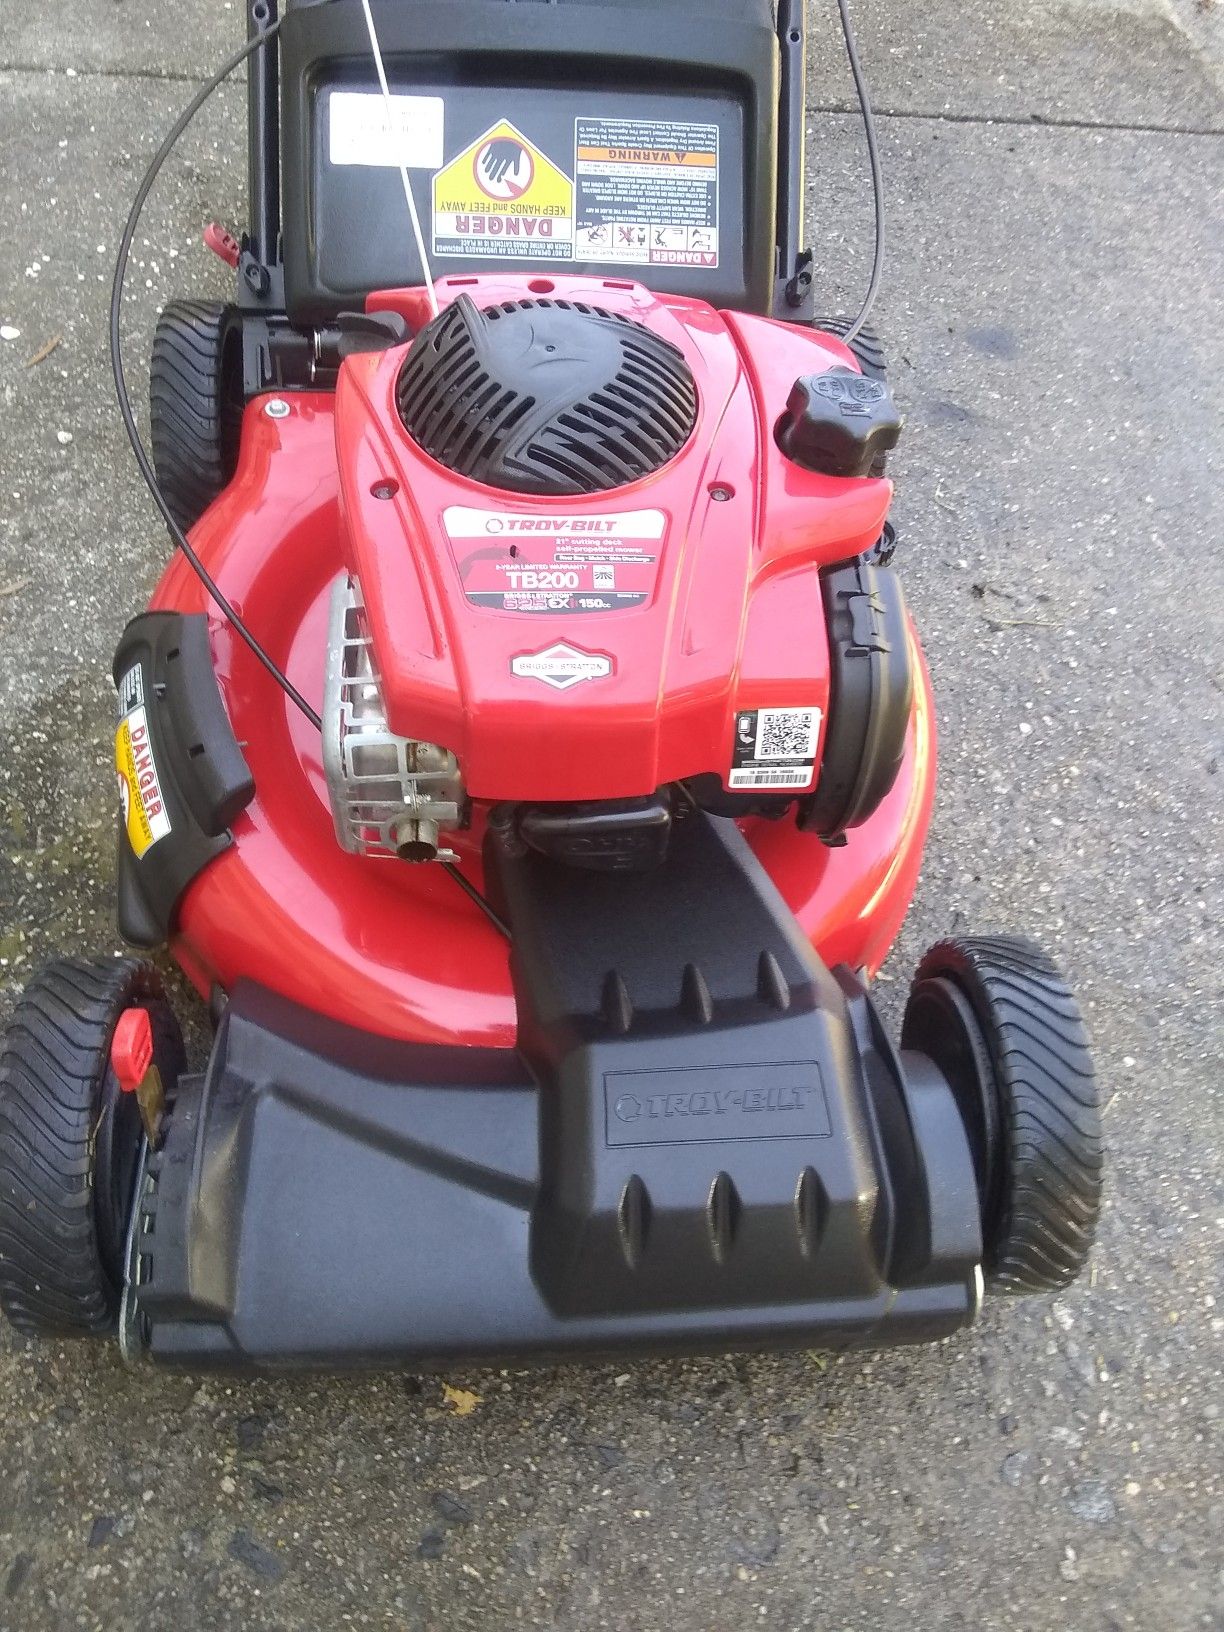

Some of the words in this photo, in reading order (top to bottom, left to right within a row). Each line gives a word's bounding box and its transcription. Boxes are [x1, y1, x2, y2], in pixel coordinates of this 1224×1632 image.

[608, 150, 670, 162] WARNING
[440, 201, 466, 211] AWAY
[470, 202, 490, 212] FEET
[493, 203, 508, 212] and
[511, 204, 540, 215] HANDS
[543, 205, 565, 216] KEEP
[456, 216, 552, 236] DANGER
[652, 251, 702, 263] DANGER
[507, 520, 617, 531] TROY-BILT
[506, 572, 579, 588] TB200
[131, 725, 162, 820] DANGER
[646, 1086, 817, 1118] TROY-BILT
